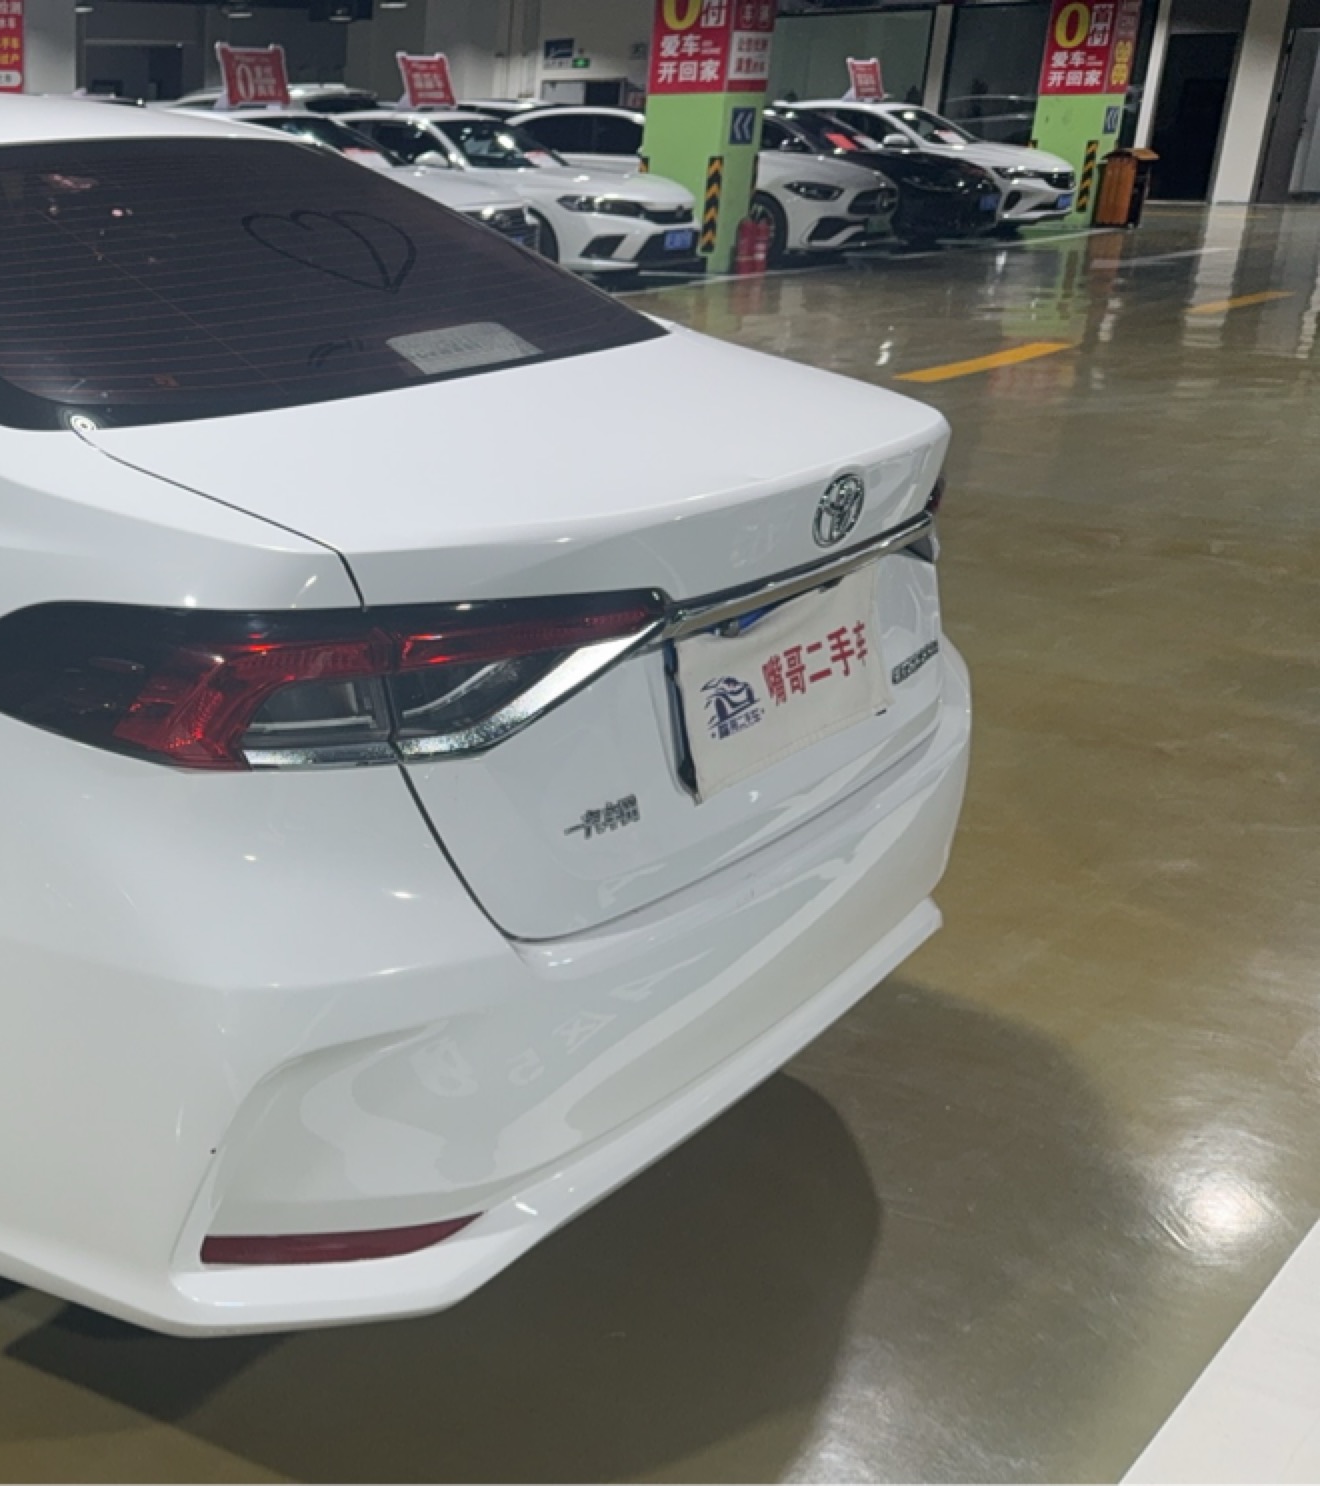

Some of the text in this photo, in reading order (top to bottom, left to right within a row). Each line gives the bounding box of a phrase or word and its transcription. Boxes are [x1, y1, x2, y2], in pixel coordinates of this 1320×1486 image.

[1055, 3, 1090, 48] 0
[660, 33, 701, 57] 爱车
[658, 58, 721, 84] 开回家
[1051, 51, 1086, 68] 爱车
[1048, 69, 1102, 87] 开回家
